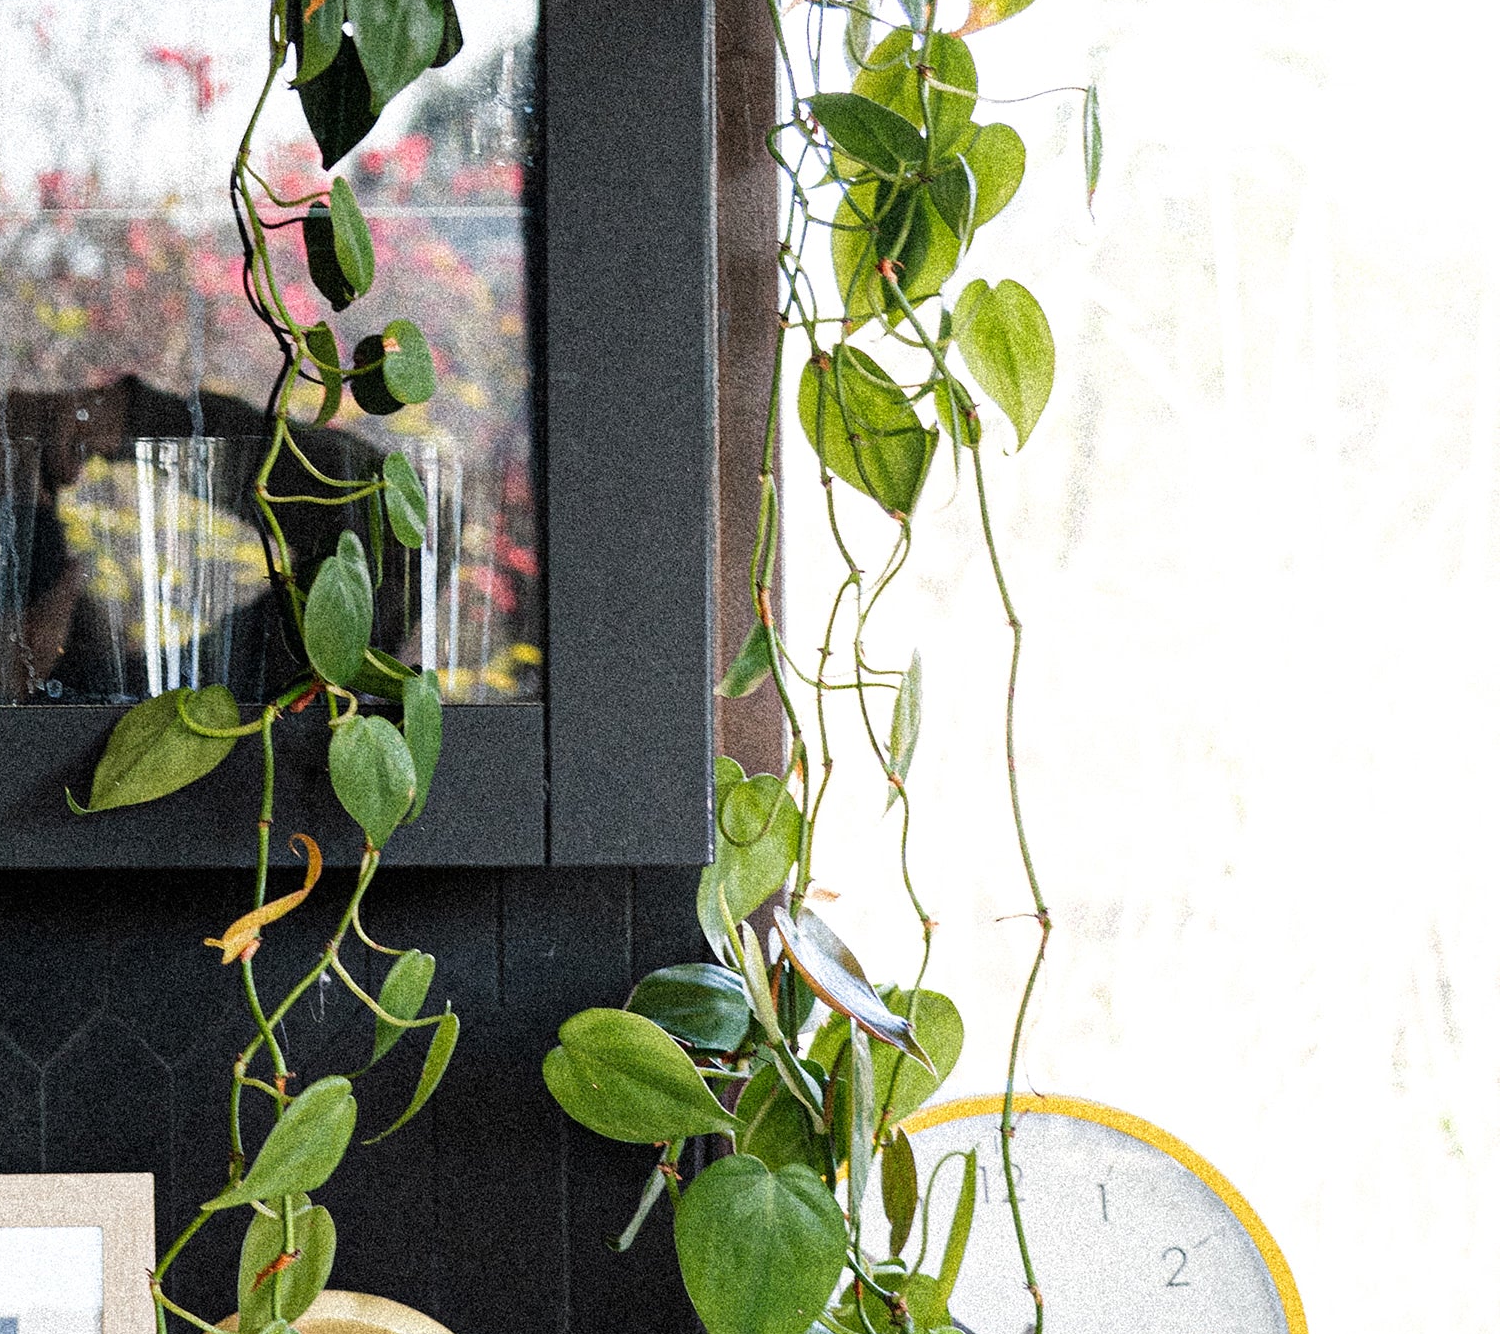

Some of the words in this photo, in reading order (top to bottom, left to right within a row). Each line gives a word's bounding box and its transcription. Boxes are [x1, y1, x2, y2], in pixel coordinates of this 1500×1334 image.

[978, 1162, 1026, 1205] 12
[1096, 1183, 1112, 1223] 1
[1161, 1246, 1190, 1288] 2
